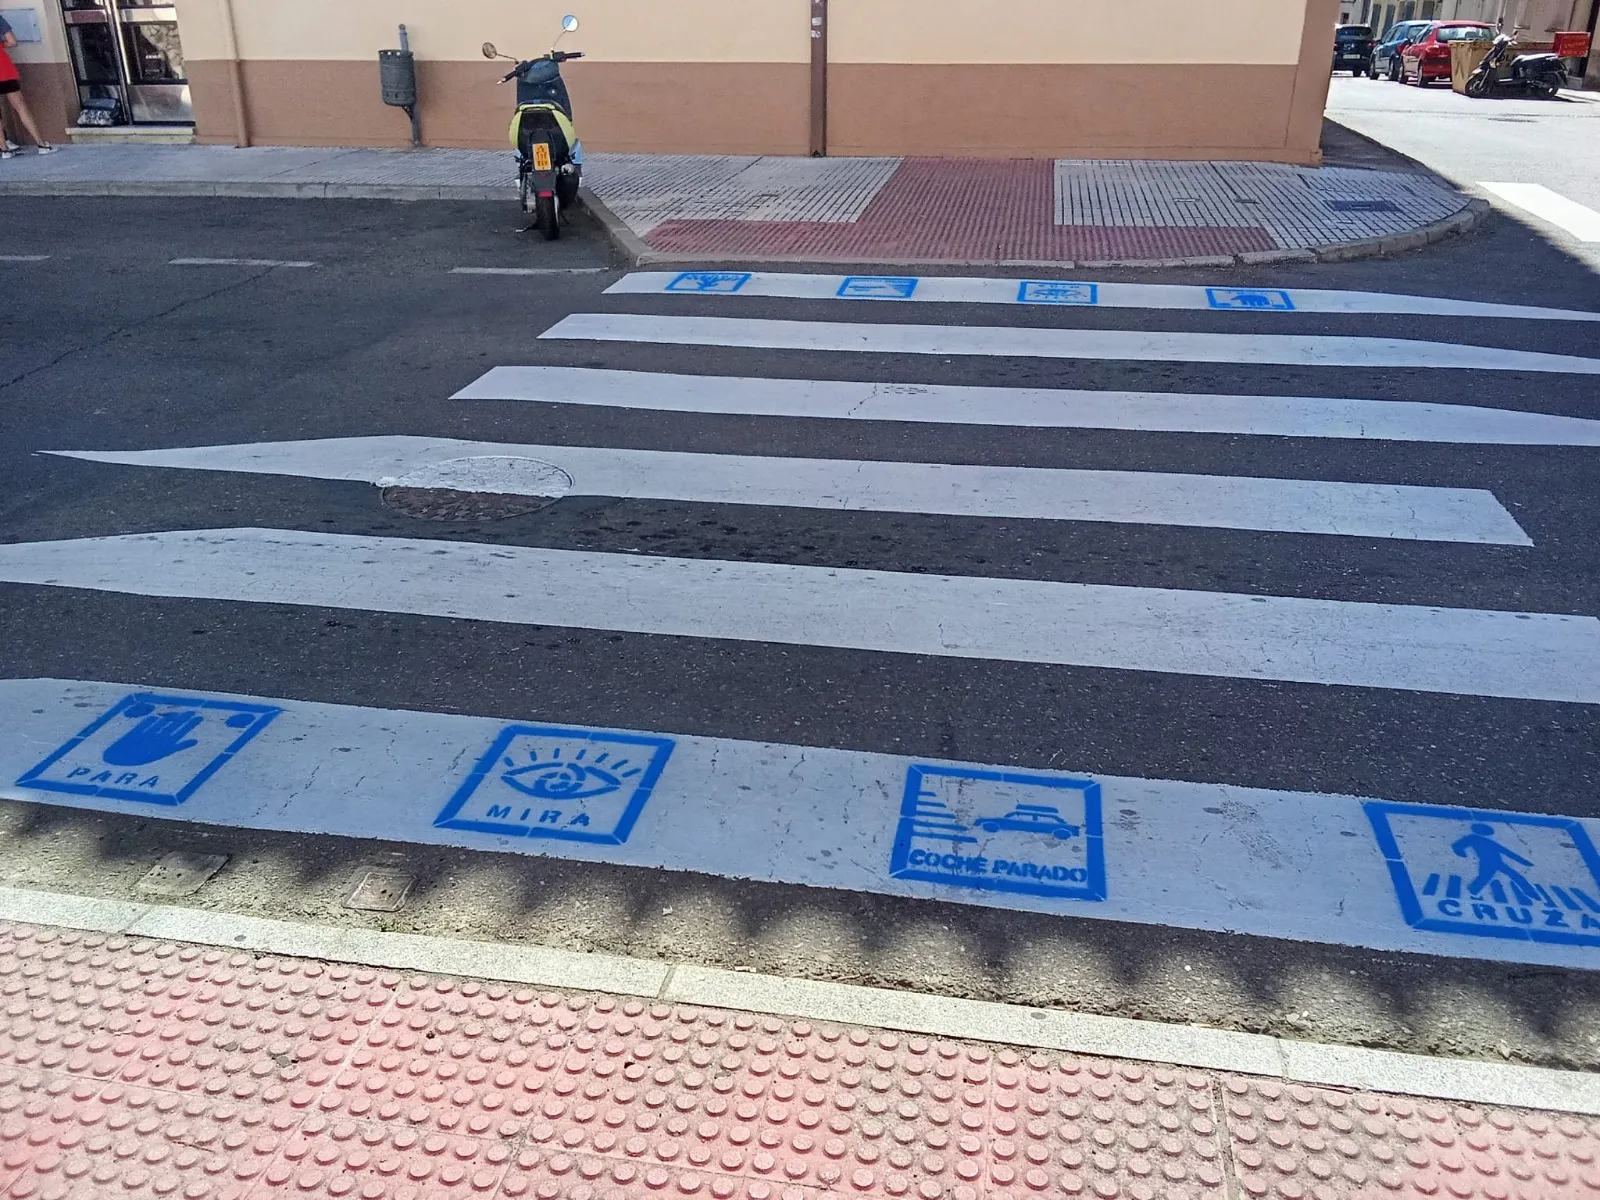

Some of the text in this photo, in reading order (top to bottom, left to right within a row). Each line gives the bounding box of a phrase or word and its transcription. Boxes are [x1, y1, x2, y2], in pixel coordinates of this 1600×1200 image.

[66, 766, 160, 788] PARA
[486, 804, 591, 827] MIRA
[908, 849, 1088, 883] COCHE PARADO
[1437, 899, 1600, 930] CRUZA
